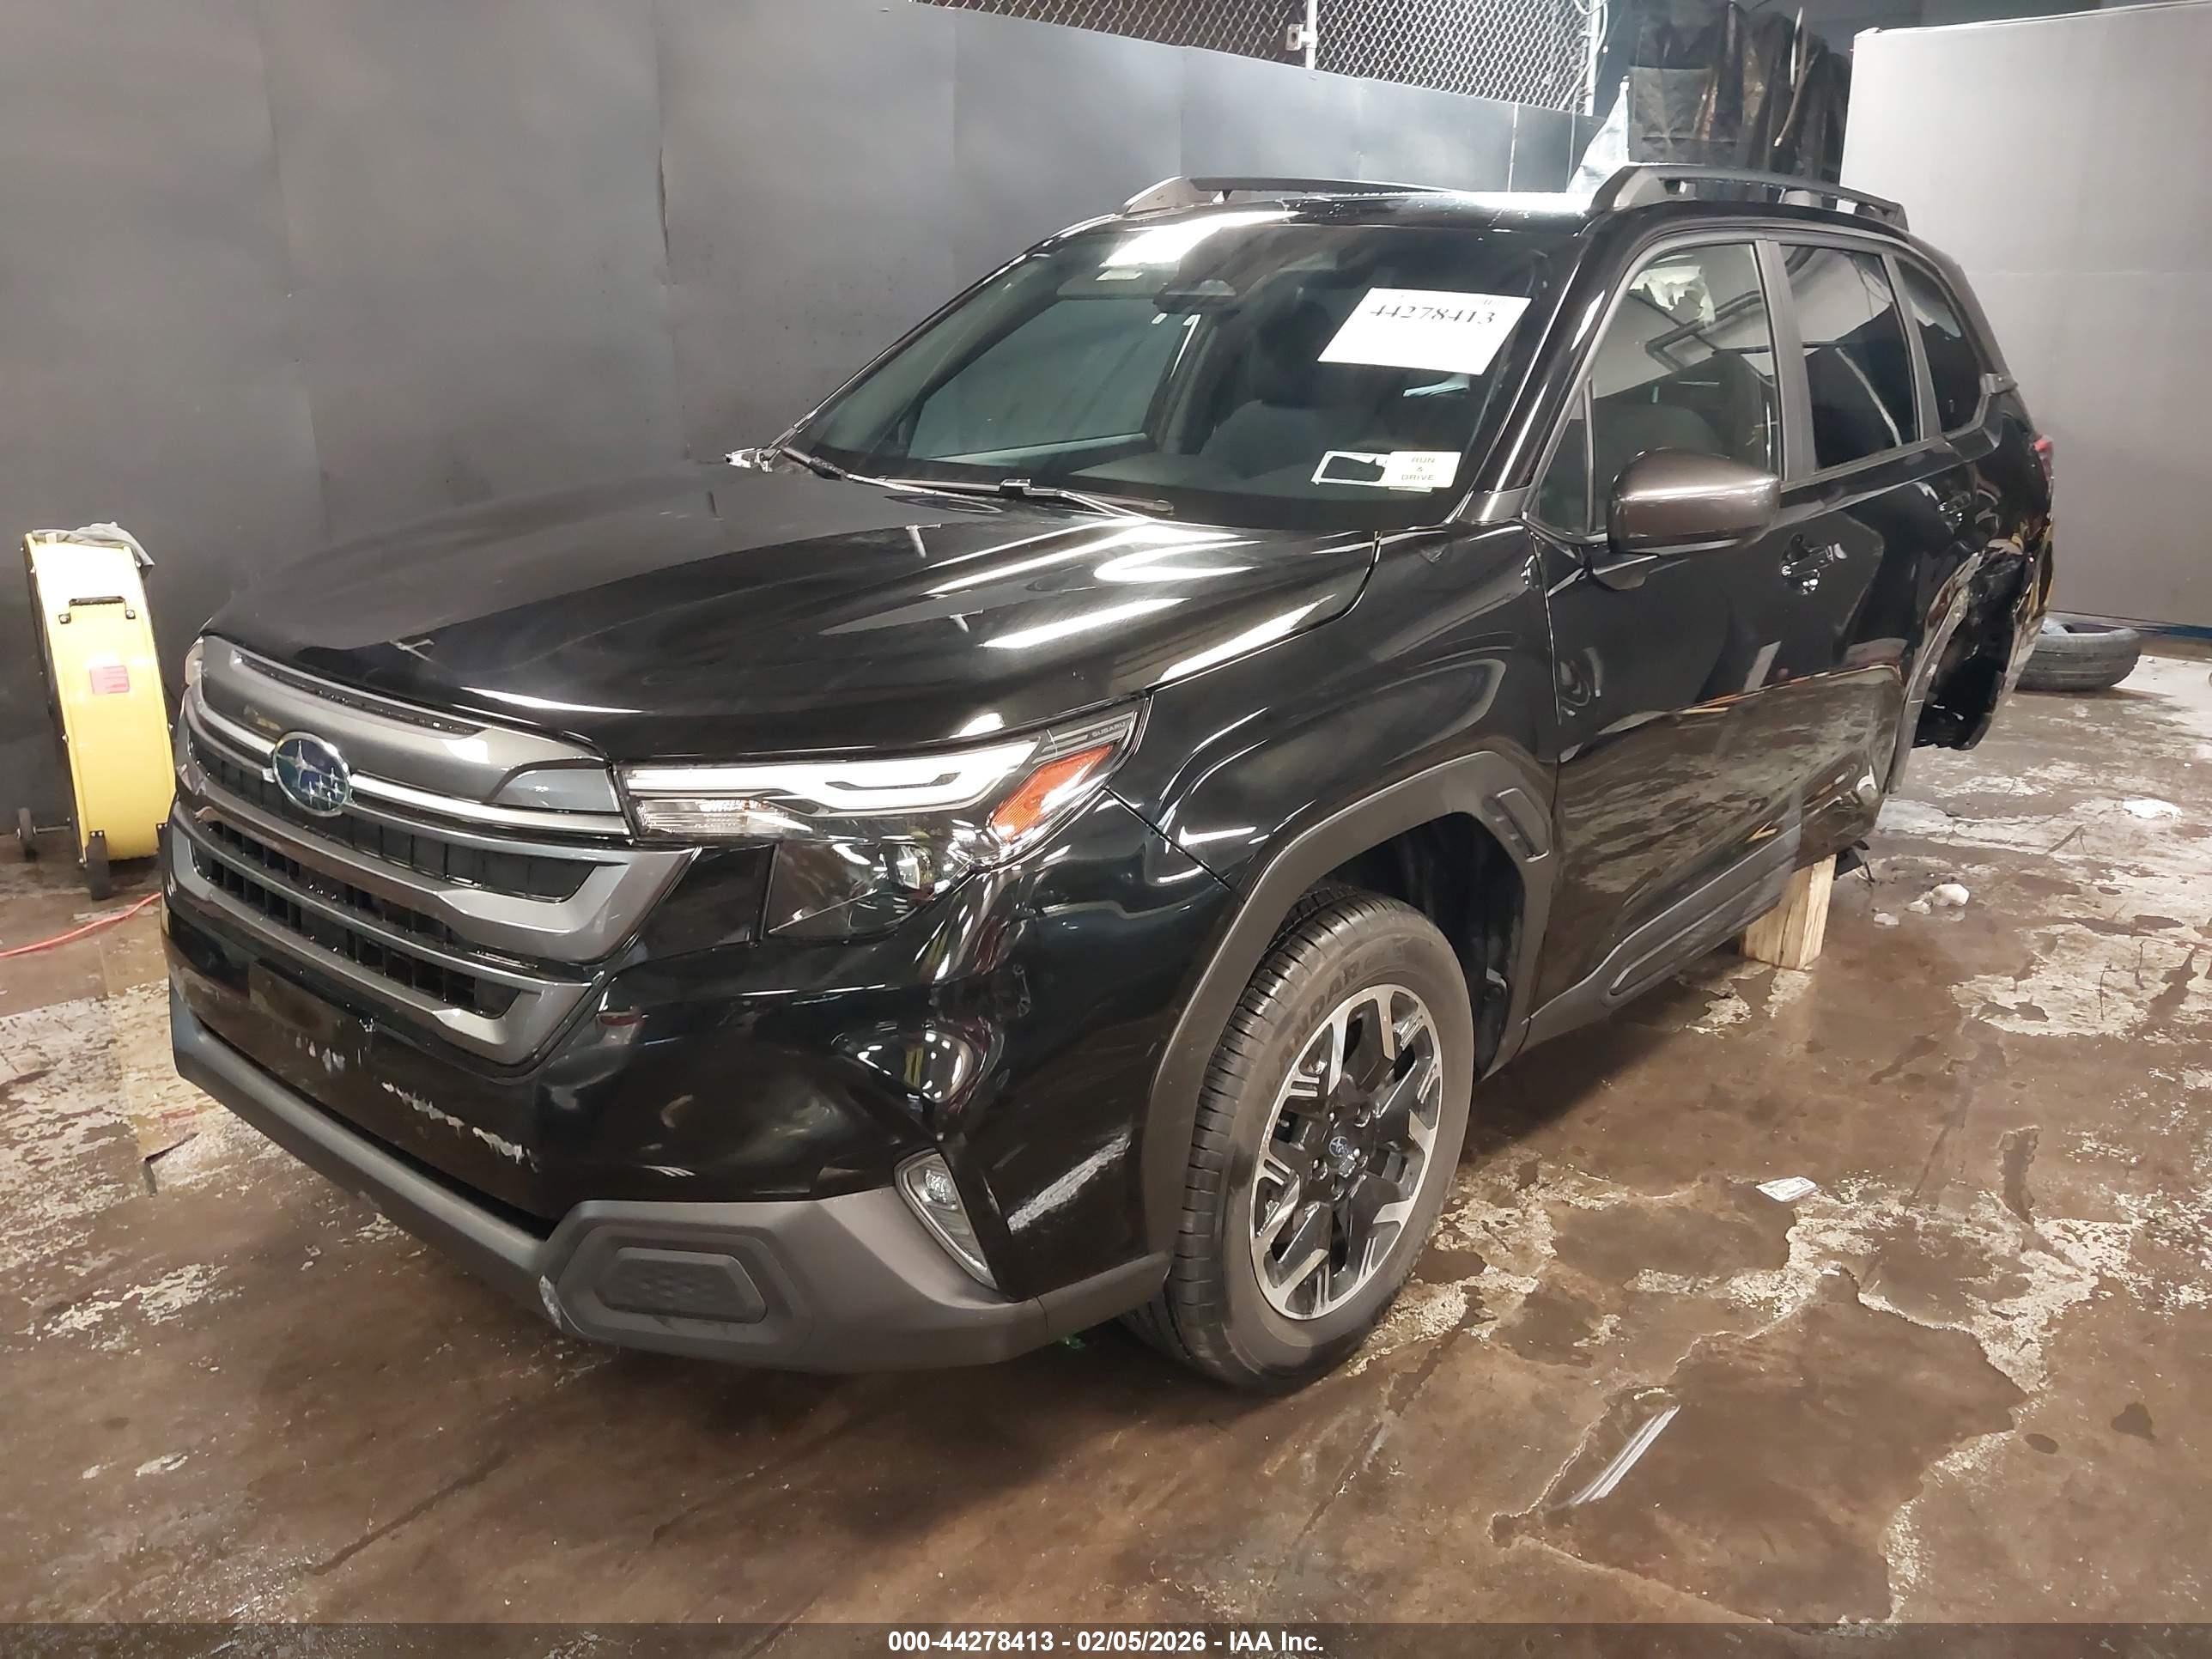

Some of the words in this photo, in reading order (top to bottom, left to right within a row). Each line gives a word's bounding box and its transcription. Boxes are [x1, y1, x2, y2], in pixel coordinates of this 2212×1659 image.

[1370, 304, 1496, 324] 44278413
[1410, 456, 1437, 465] RUN
[1091, 721, 1127, 737] SUBARU
